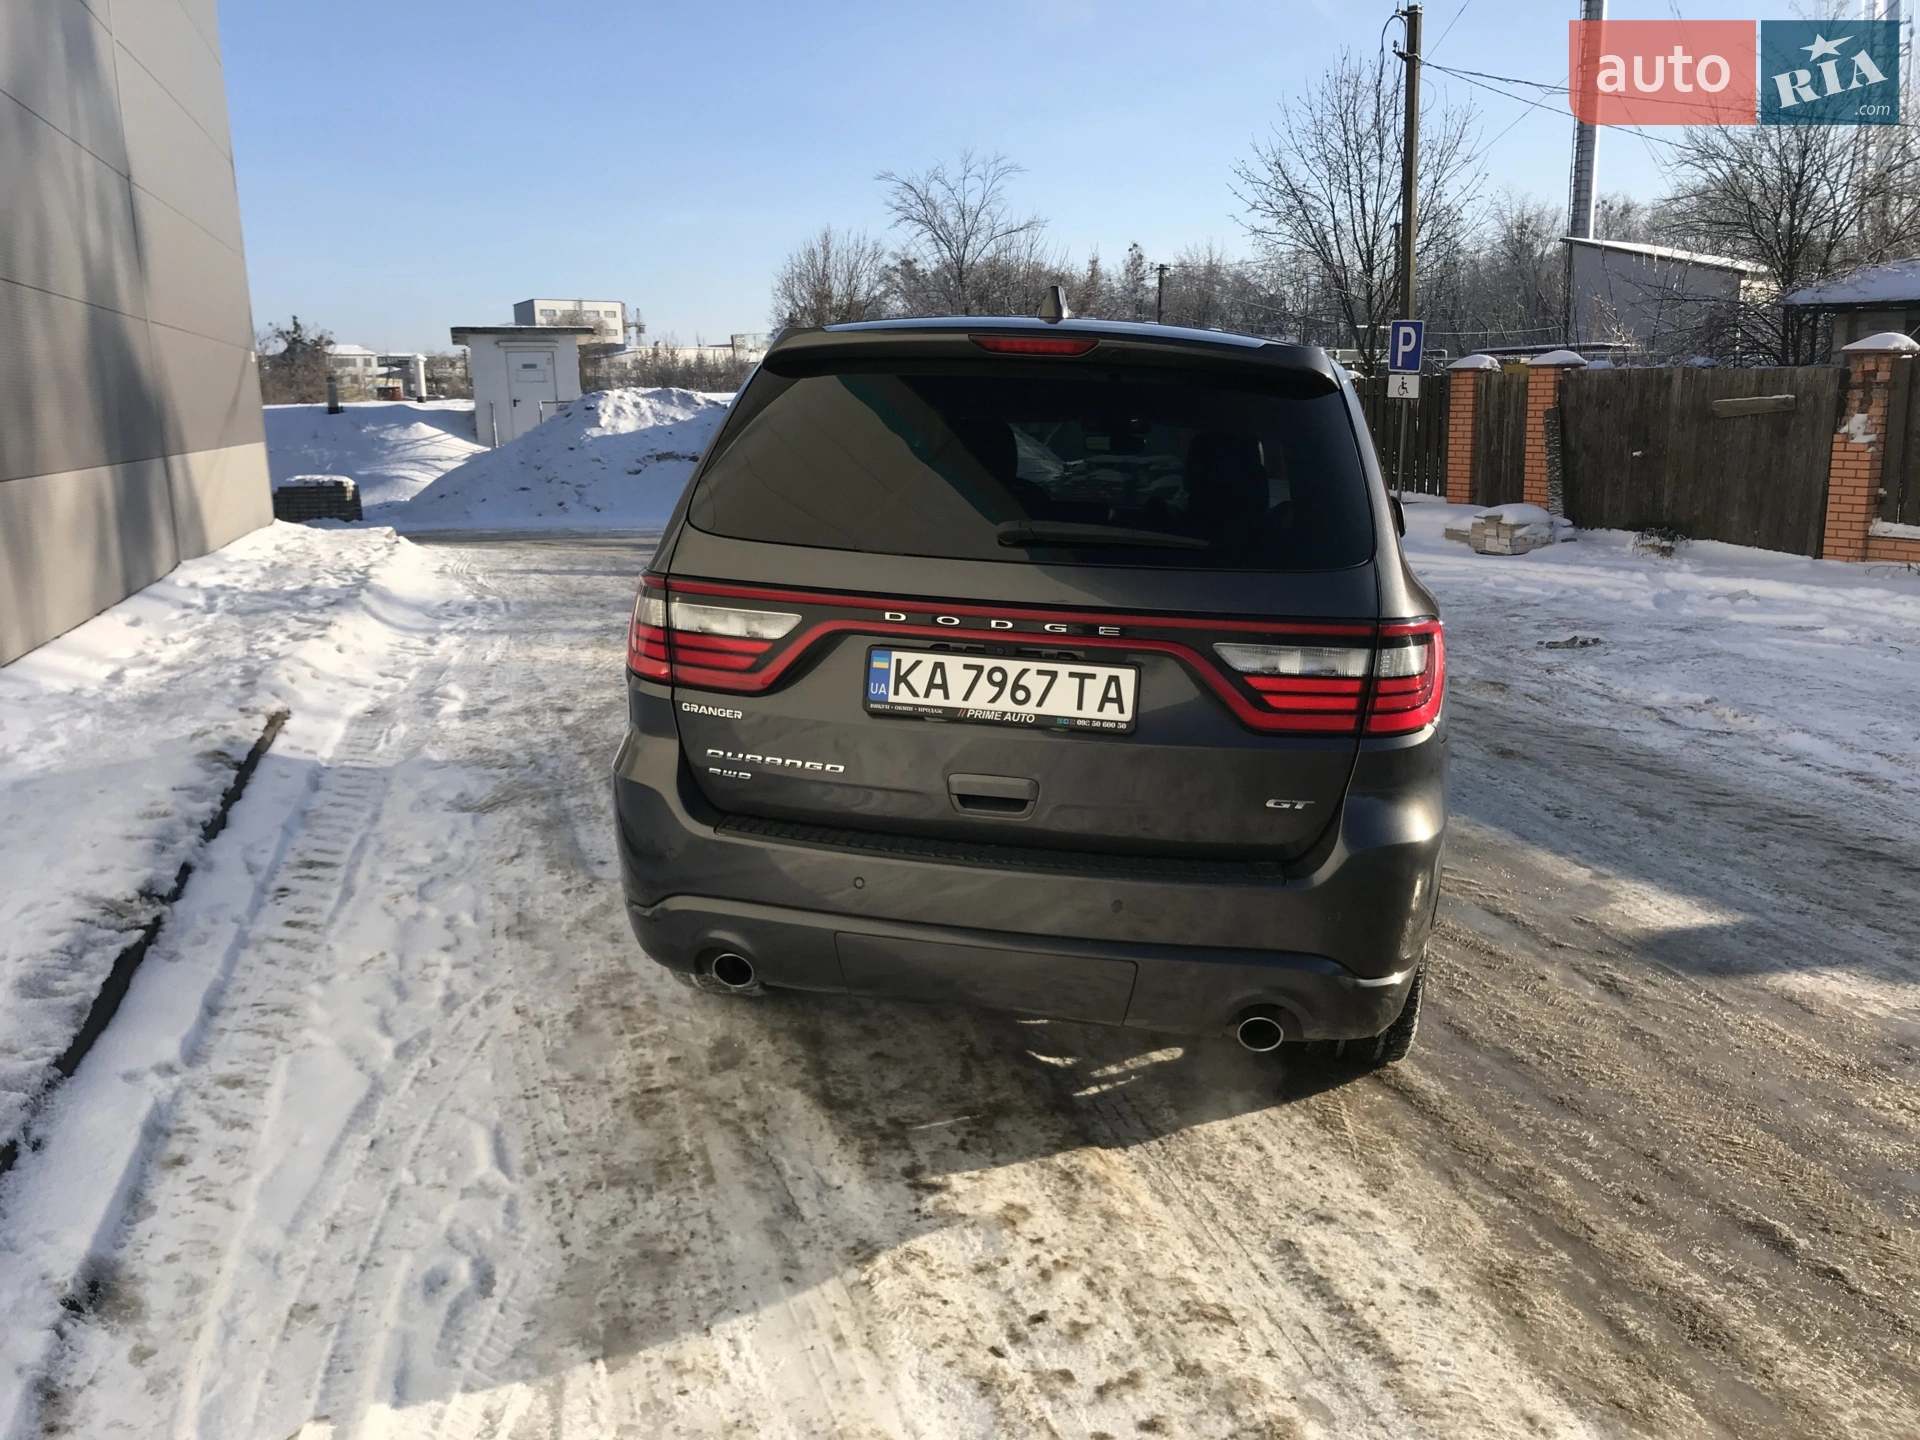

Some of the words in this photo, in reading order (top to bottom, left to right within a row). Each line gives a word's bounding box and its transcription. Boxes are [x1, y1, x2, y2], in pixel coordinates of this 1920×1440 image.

[1396, 326, 1417, 367] P
[884, 612, 1121, 636] DODGE
[870, 682, 887, 695] UA
[893, 658, 951, 701] KA
[961, 663, 1059, 708] 7967
[1068, 671, 1126, 714] TA
[682, 702, 743, 720] GRANGER
[1003, 712, 1036, 724] AUTO
[706, 748, 845, 773] DURANGO
[708, 767, 752, 780] AWD
[1265, 799, 1315, 809] GT
